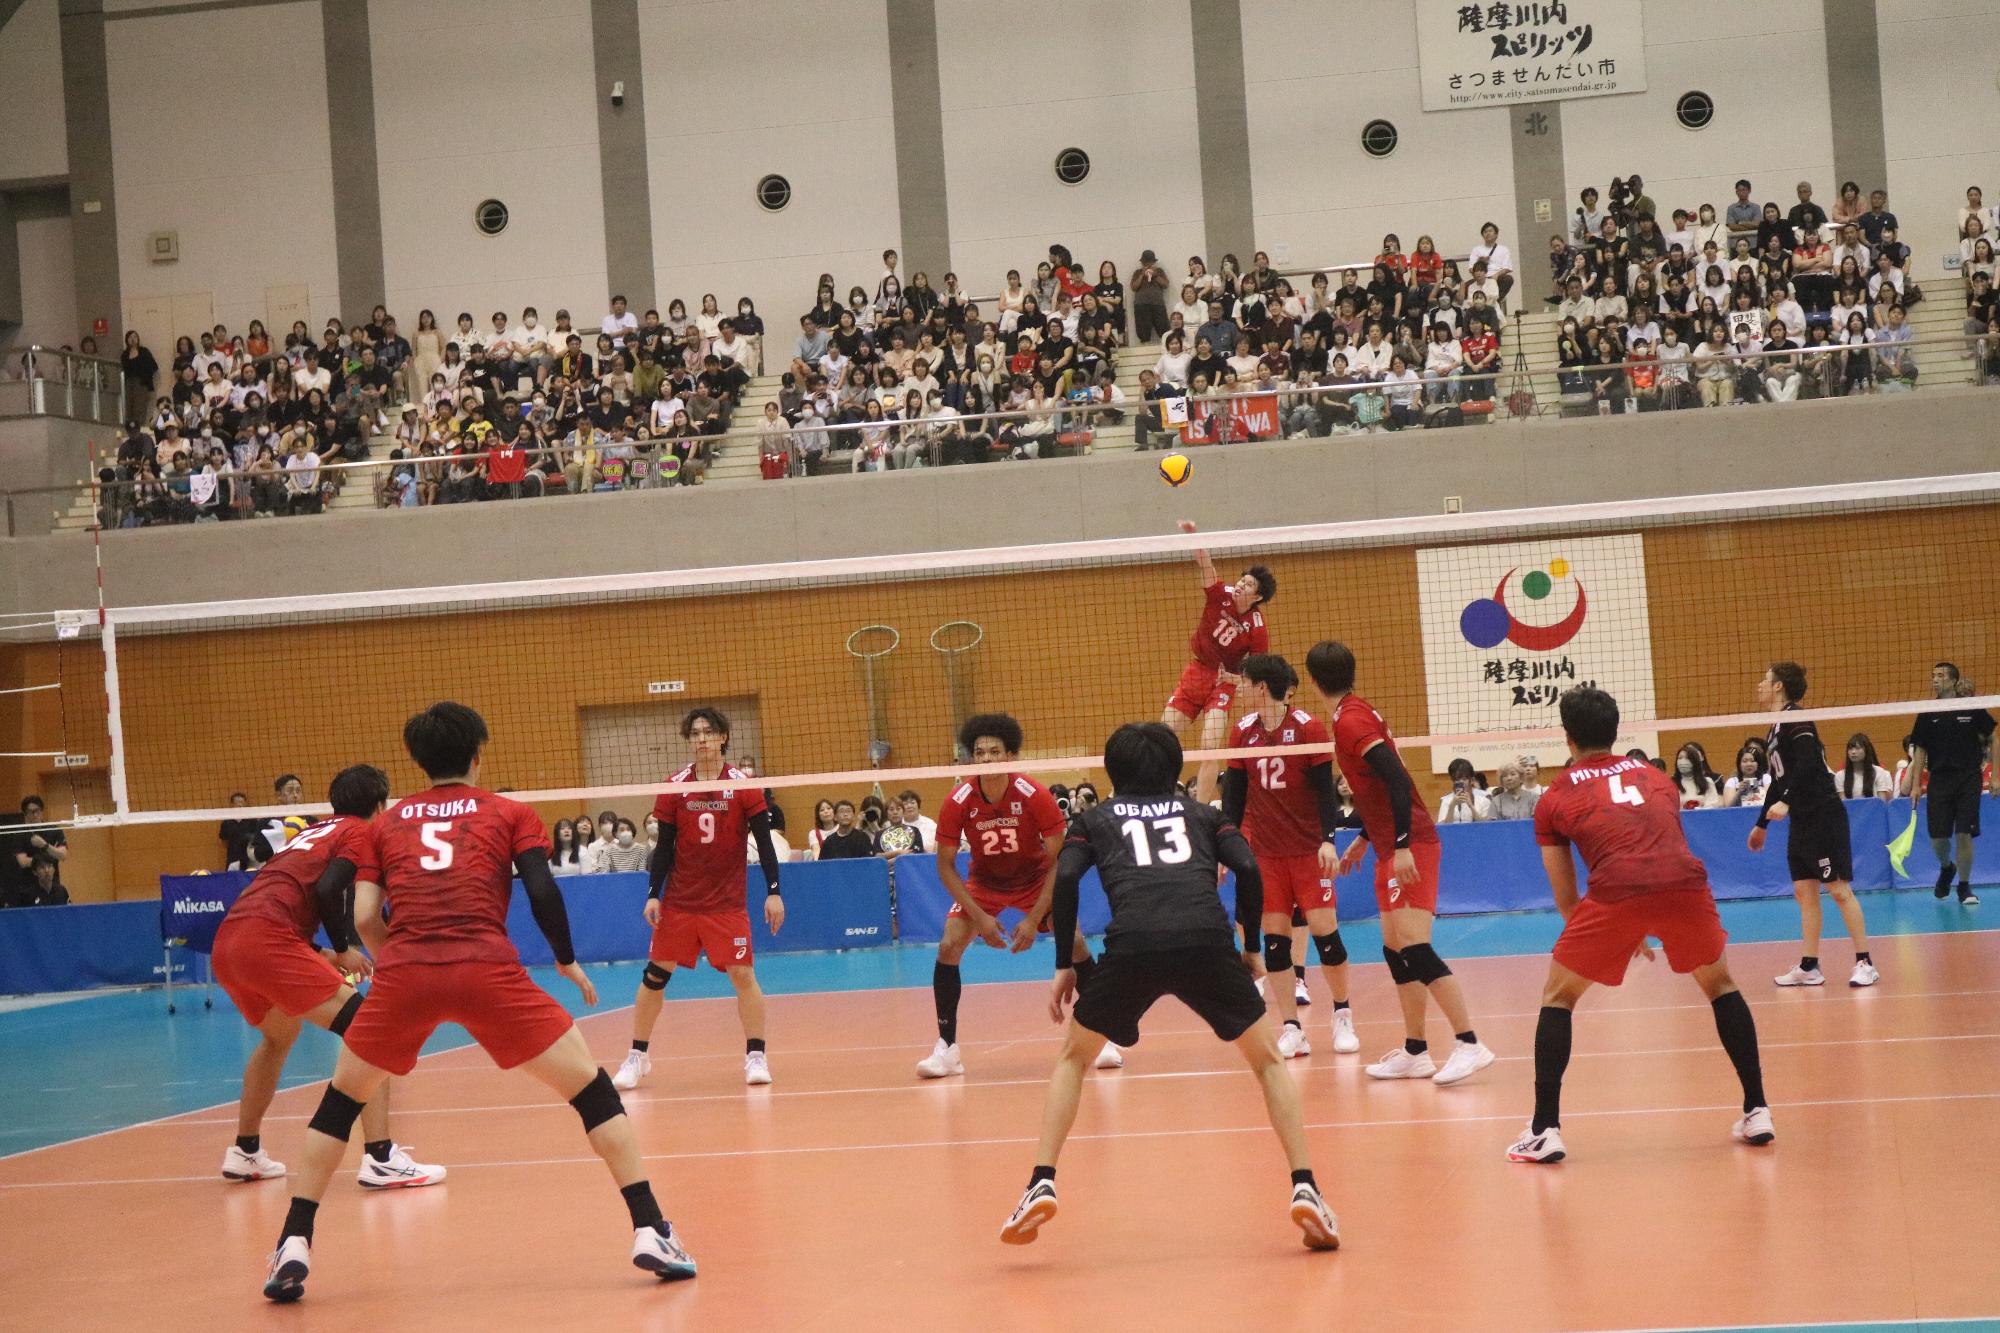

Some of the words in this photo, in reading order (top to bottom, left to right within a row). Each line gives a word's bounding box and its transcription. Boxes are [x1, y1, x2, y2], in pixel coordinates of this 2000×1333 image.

[1457, 1, 1567, 33] 薩摩川内
[1491, 24, 1593, 61] スピリッツ
[1449, 58, 1616, 90] さつませんだい市
[1525, 112, 1548, 136] 北
[1213, 619, 1238, 647] 18
[1484, 656, 1575, 684] 薩摩川内
[1257, 757, 1287, 789] 12
[1608, 774, 1645, 806] 4
[401, 798, 478, 819] OTSUKA
[1113, 801, 1185, 818] OGAWA
[698, 812, 715, 844] 9
[981, 828, 1019, 856] 23
[1122, 817, 1193, 867] 13
[420, 821, 454, 871] 5
